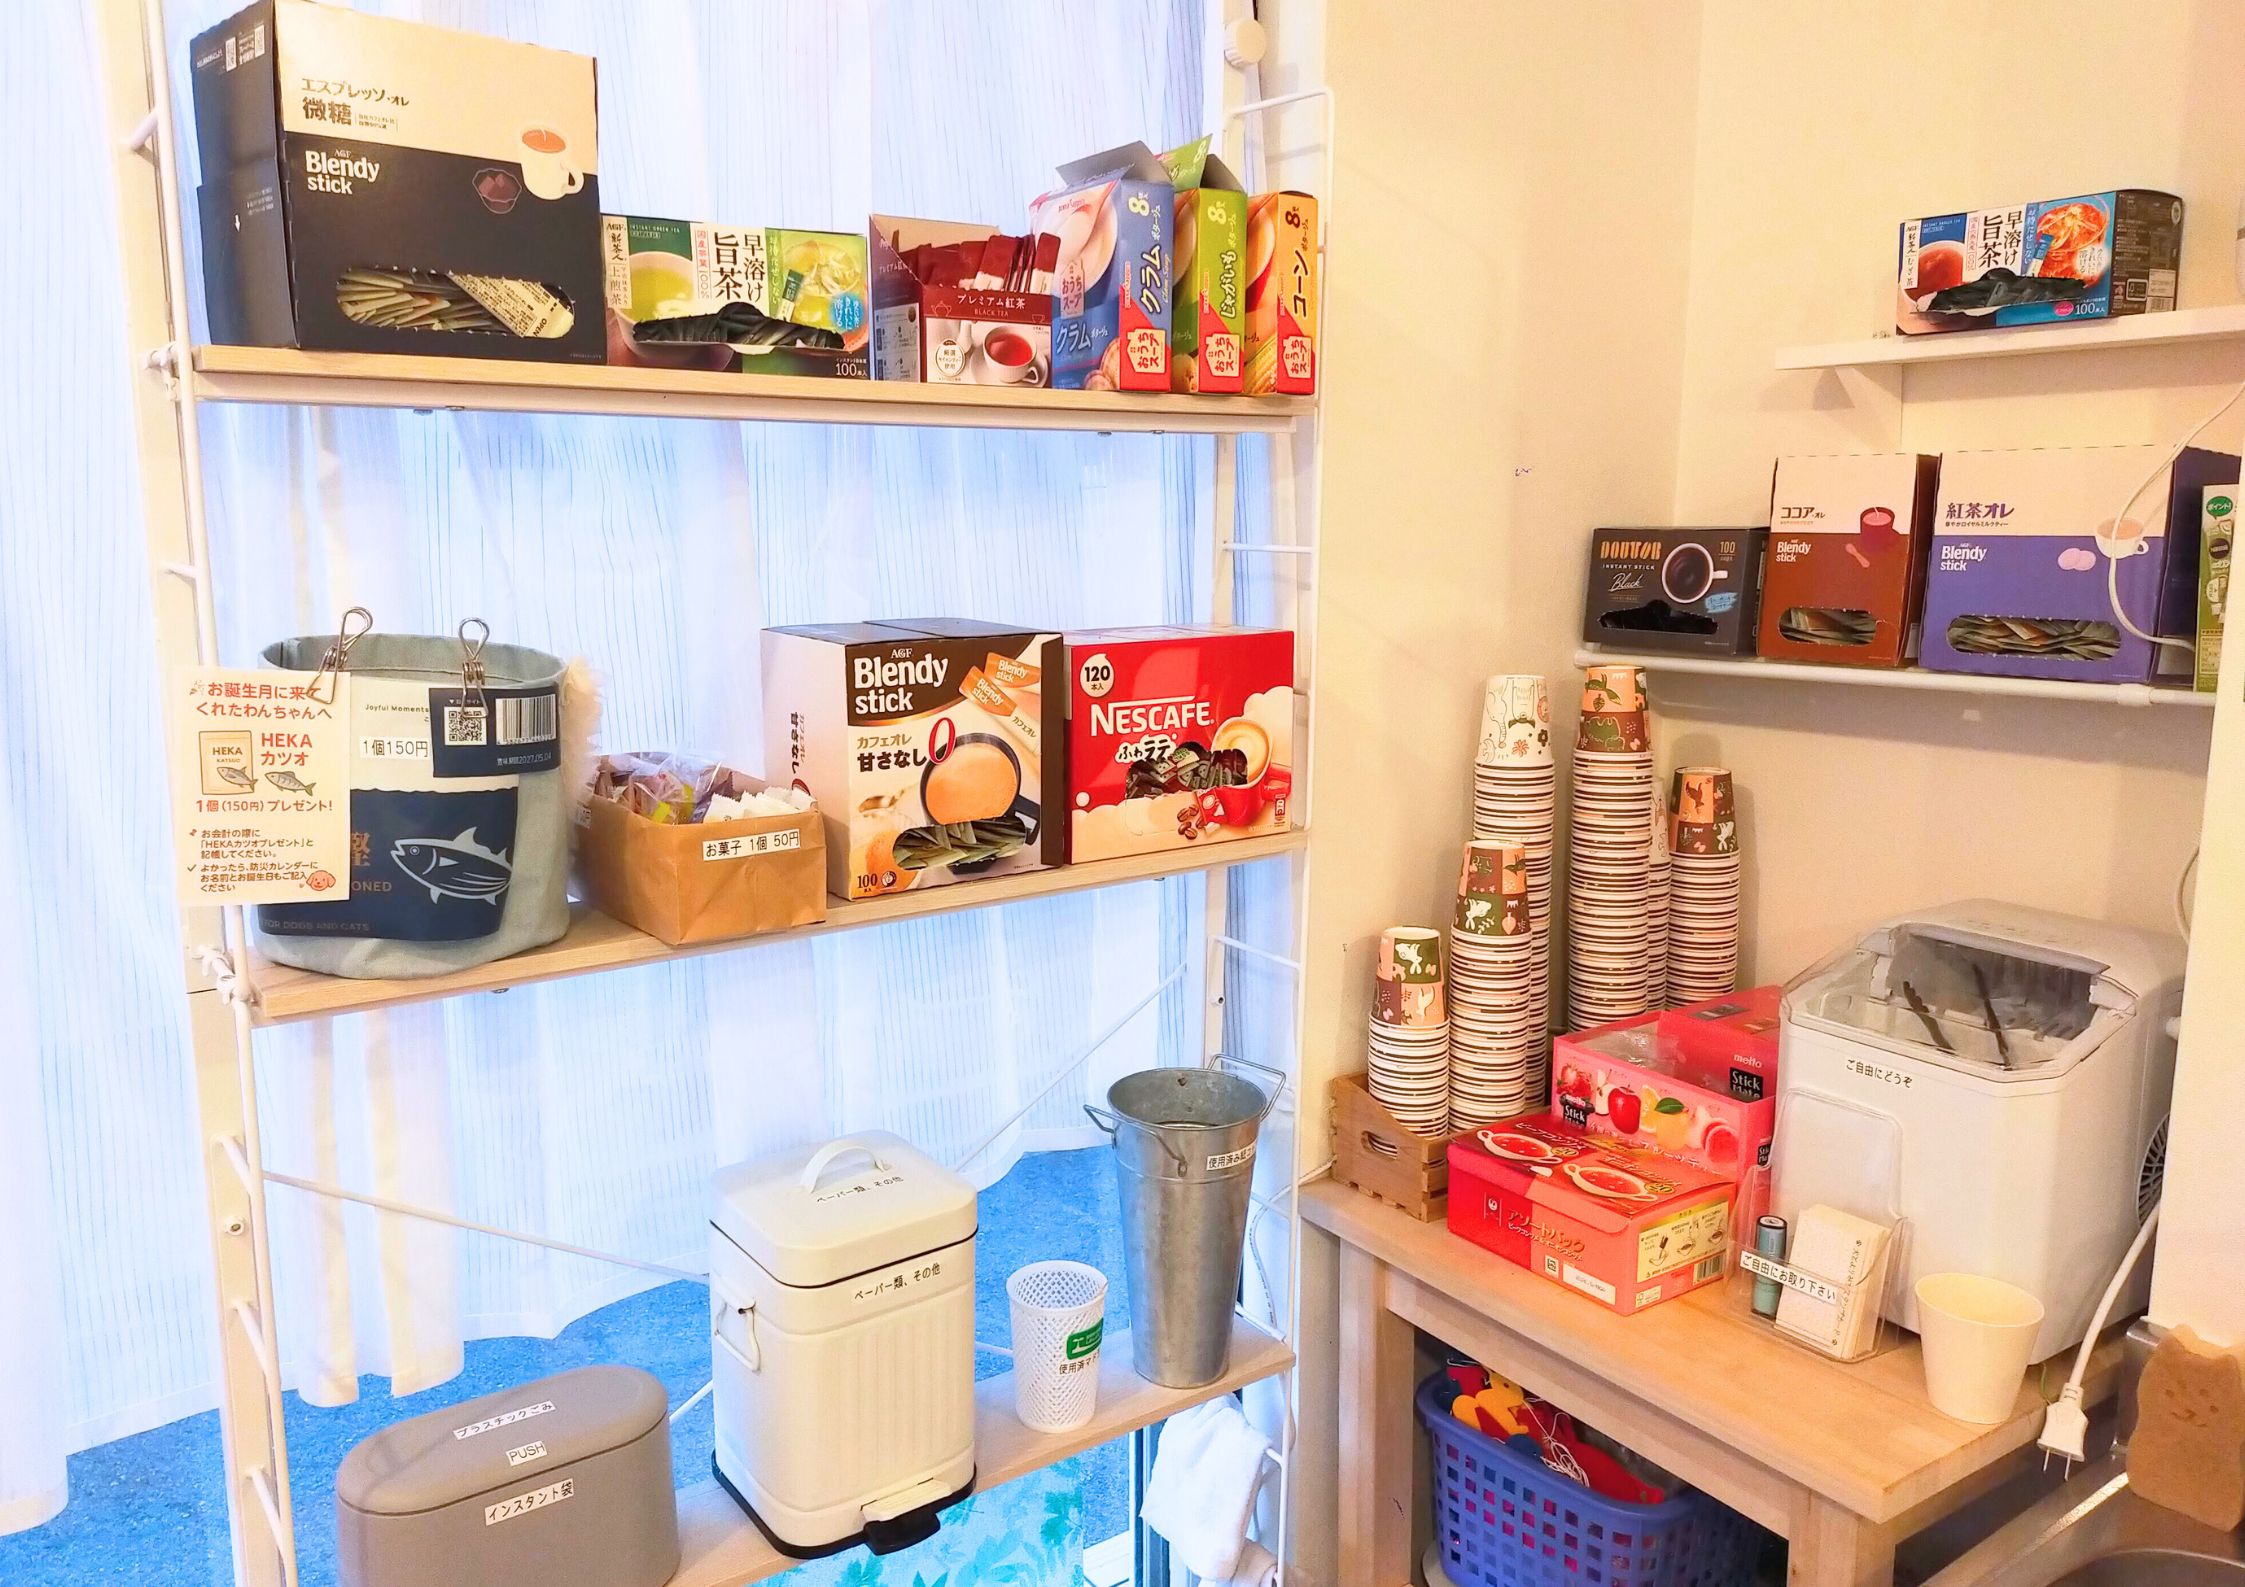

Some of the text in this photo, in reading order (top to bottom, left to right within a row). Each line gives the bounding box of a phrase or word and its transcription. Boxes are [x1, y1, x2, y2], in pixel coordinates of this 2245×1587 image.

[302, 96, 352, 126] 微糖
[305, 150, 380, 183] Blendy
[307, 174, 353, 195] stick
[1978, 214, 2004, 268] 旨茶
[2003, 210, 2023, 266] 早溶け
[711, 231, 743, 300] 旨茶
[742, 234, 766, 303] 早溶け
[1061, 276, 1083, 295] おうち
[1140, 244, 1161, 314] クラム
[1220, 250, 1237, 318] じゃがいも
[1292, 250, 1308, 318] コーン
[957, 293, 1027, 310] プレミアム紅茶
[1062, 295, 1083, 310] スープ
[1056, 323, 1092, 355] クラム
[1137, 332, 1149, 369] おうち
[1149, 333, 1160, 368] スープ
[1214, 337, 1226, 372] おうち
[1225, 337, 1235, 371] スープ
[1290, 339, 1300, 374] おうち
[1299, 340, 1308, 373] スープ
[1945, 502, 2015, 519] 紅茶オレ
[1600, 541, 1662, 560] DOUTOR
[1719, 541, 1736, 554] 100
[1775, 553, 1797, 563] stick
[1776, 541, 1812, 555] Blendy
[1941, 545, 1988, 562] Blendy
[1940, 560, 1968, 571] stick
[1608, 572, 1643, 593] Black
[890, 648, 913, 659] AGF
[853, 653, 949, 689] Blendy
[995, 671, 1015, 683] stick
[998, 660, 1028, 679] Blendy
[1084, 665, 1111, 682] 120
[207, 682, 321, 700] お誕生月に来て
[972, 687, 990, 705] stick
[976, 678, 1004, 706] Blendy
[1091, 683, 1104, 691] 本入
[196, 702, 333, 720] くれたわんちゃんへ
[365, 704, 390, 713] Joyful
[855, 687, 914, 715] stick
[1012, 716, 1037, 738] カフェオレ
[261, 733, 313, 748] HEKA
[363, 740, 429, 758] 1個150円
[790, 711, 800, 775] 甘さなし
[856, 733, 912, 749] カフェオレ
[212, 747, 243, 756] HEKA
[260, 751, 309, 766] カツオ
[857, 748, 927, 773] 甘さなし
[201, 829, 261, 839] お会計の際に
[705, 831, 799, 857] お菓子 1個 50円
[200, 884, 236, 893] ください
[351, 881, 392, 892] ONED
[857, 873, 878, 889] 100
[1733, 1054, 1762, 1069] meito
[1732, 1070, 1760, 1091] Stick
[1846, 1059, 1913, 1089] ご自由にどうぞ
[1565, 1105, 1585, 1122] Stick
[1508, 1210, 1585, 1253] アソートパック
[854, 1262, 941, 1300] ペーパー類、その他
[1742, 1255, 1836, 1300] ご自由にお取り下さい
[457, 1403, 552, 1437] プラスチックごみ
[508, 1443, 545, 1461] PUSH
[489, 1481, 573, 1521] インスタント袋
